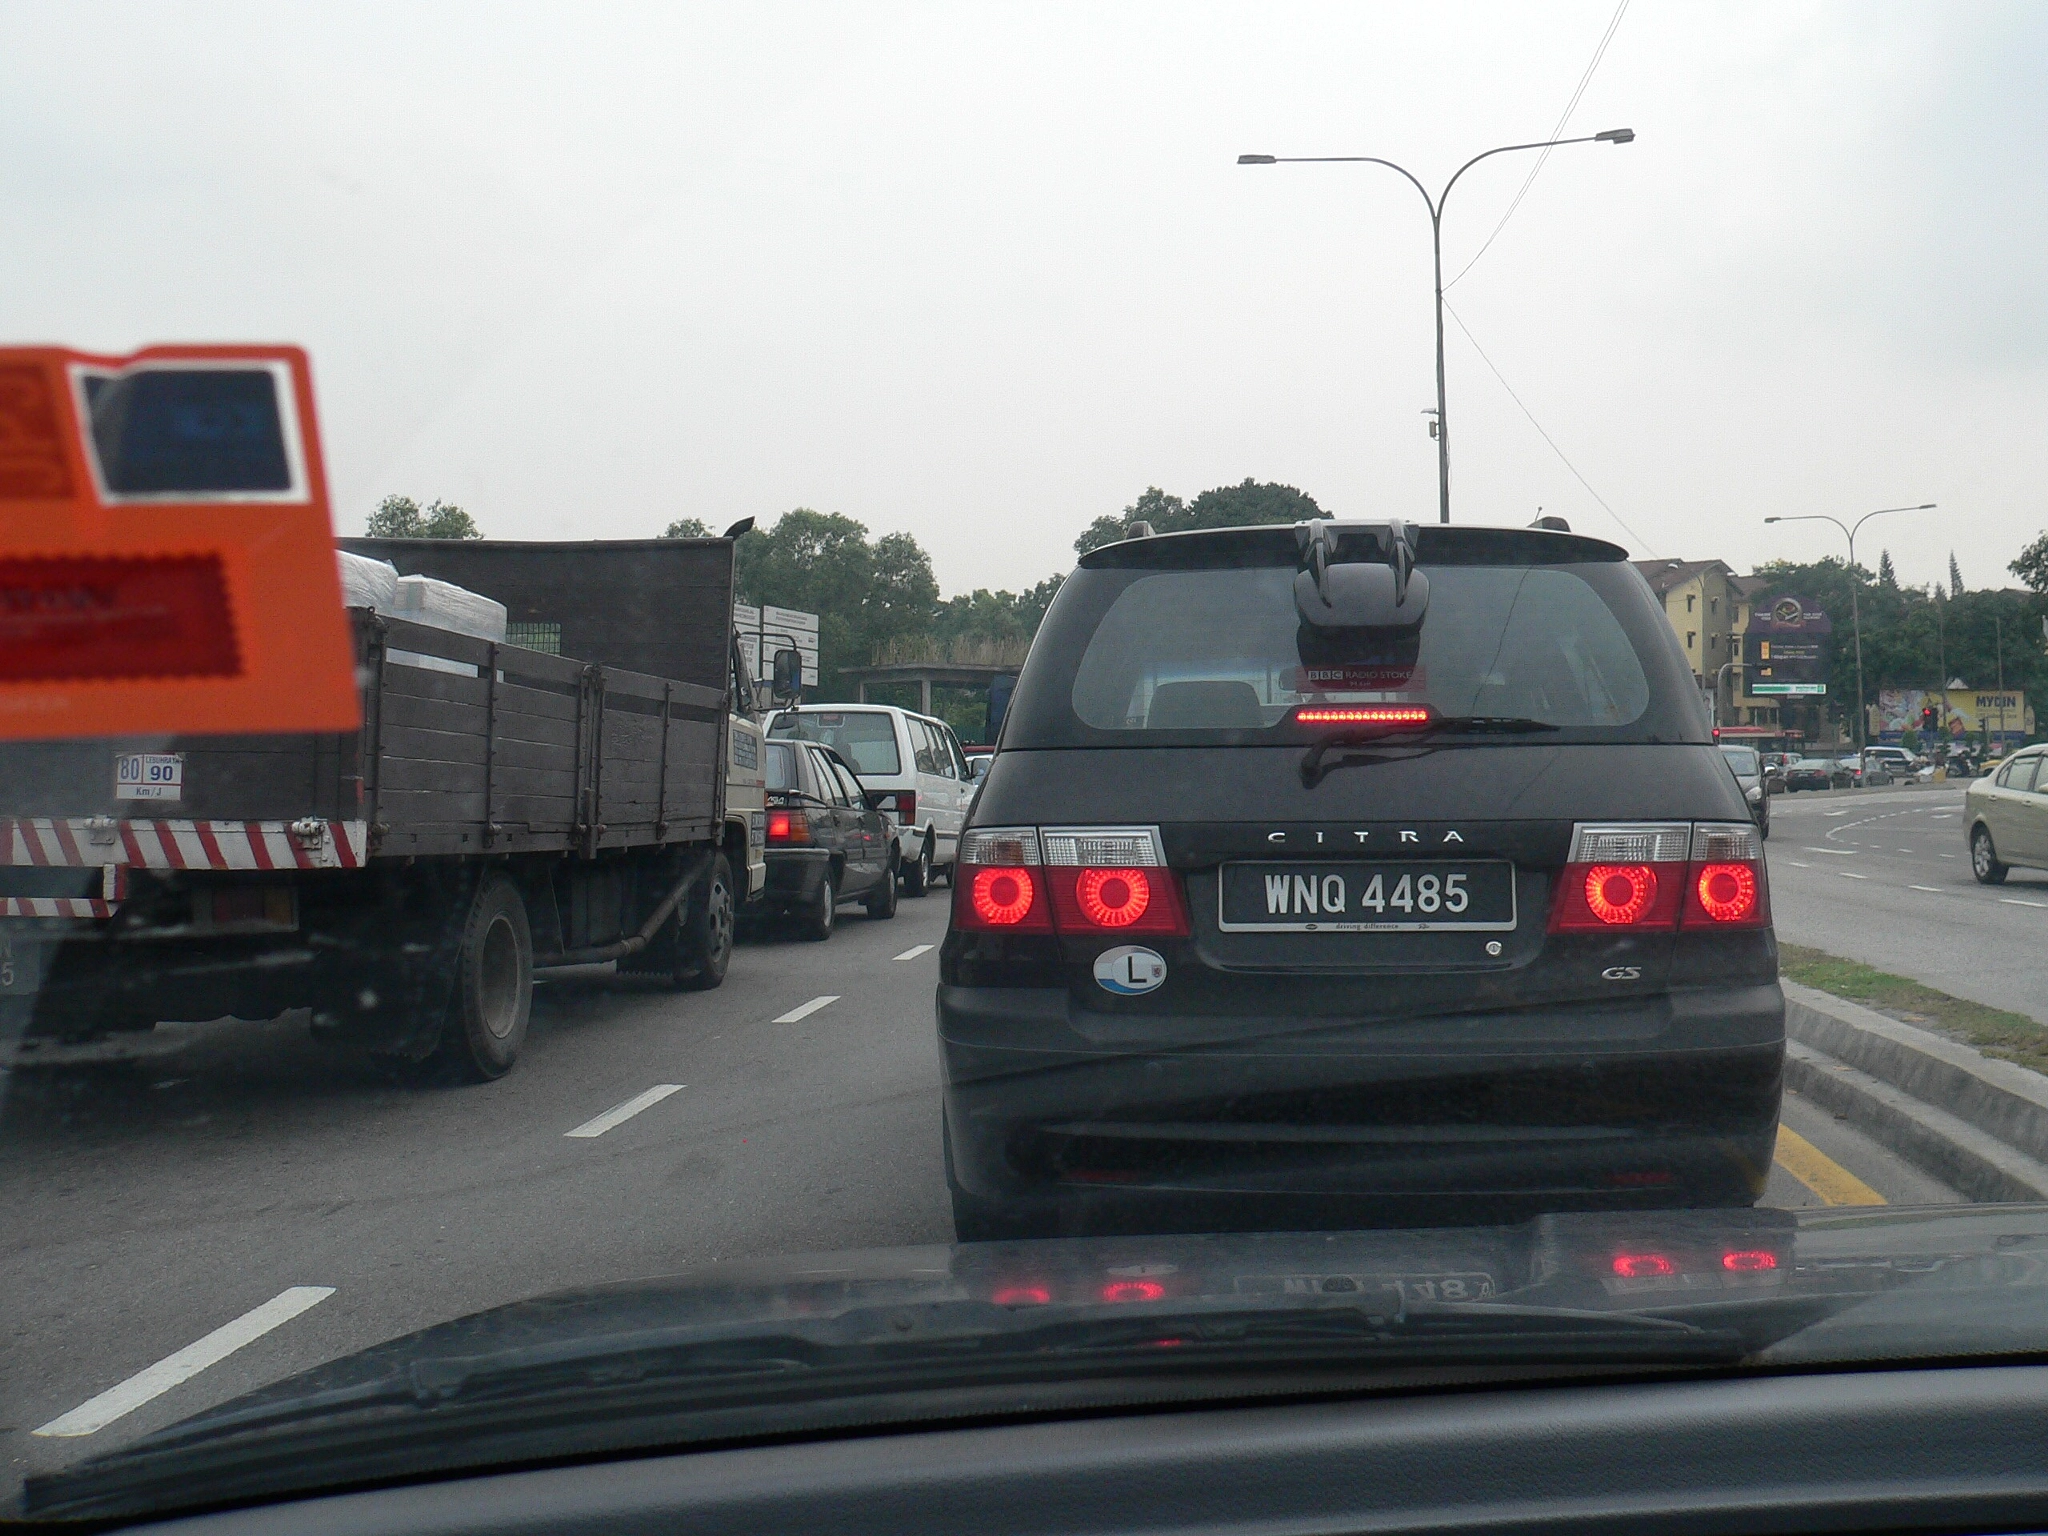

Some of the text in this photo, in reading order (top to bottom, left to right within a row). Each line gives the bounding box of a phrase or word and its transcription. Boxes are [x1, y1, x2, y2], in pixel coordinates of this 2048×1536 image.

[1308, 670, 1343, 680] BBC
[1345, 671, 1377, 679] RADIO
[120, 757, 140, 780] 80
[150, 765, 173, 781] 90
[1267, 831, 1465, 843] CITRA
[1264, 873, 1470, 914] WNQ 4485
[1127, 955, 1148, 984] L
[1601, 966, 1642, 980] GS
